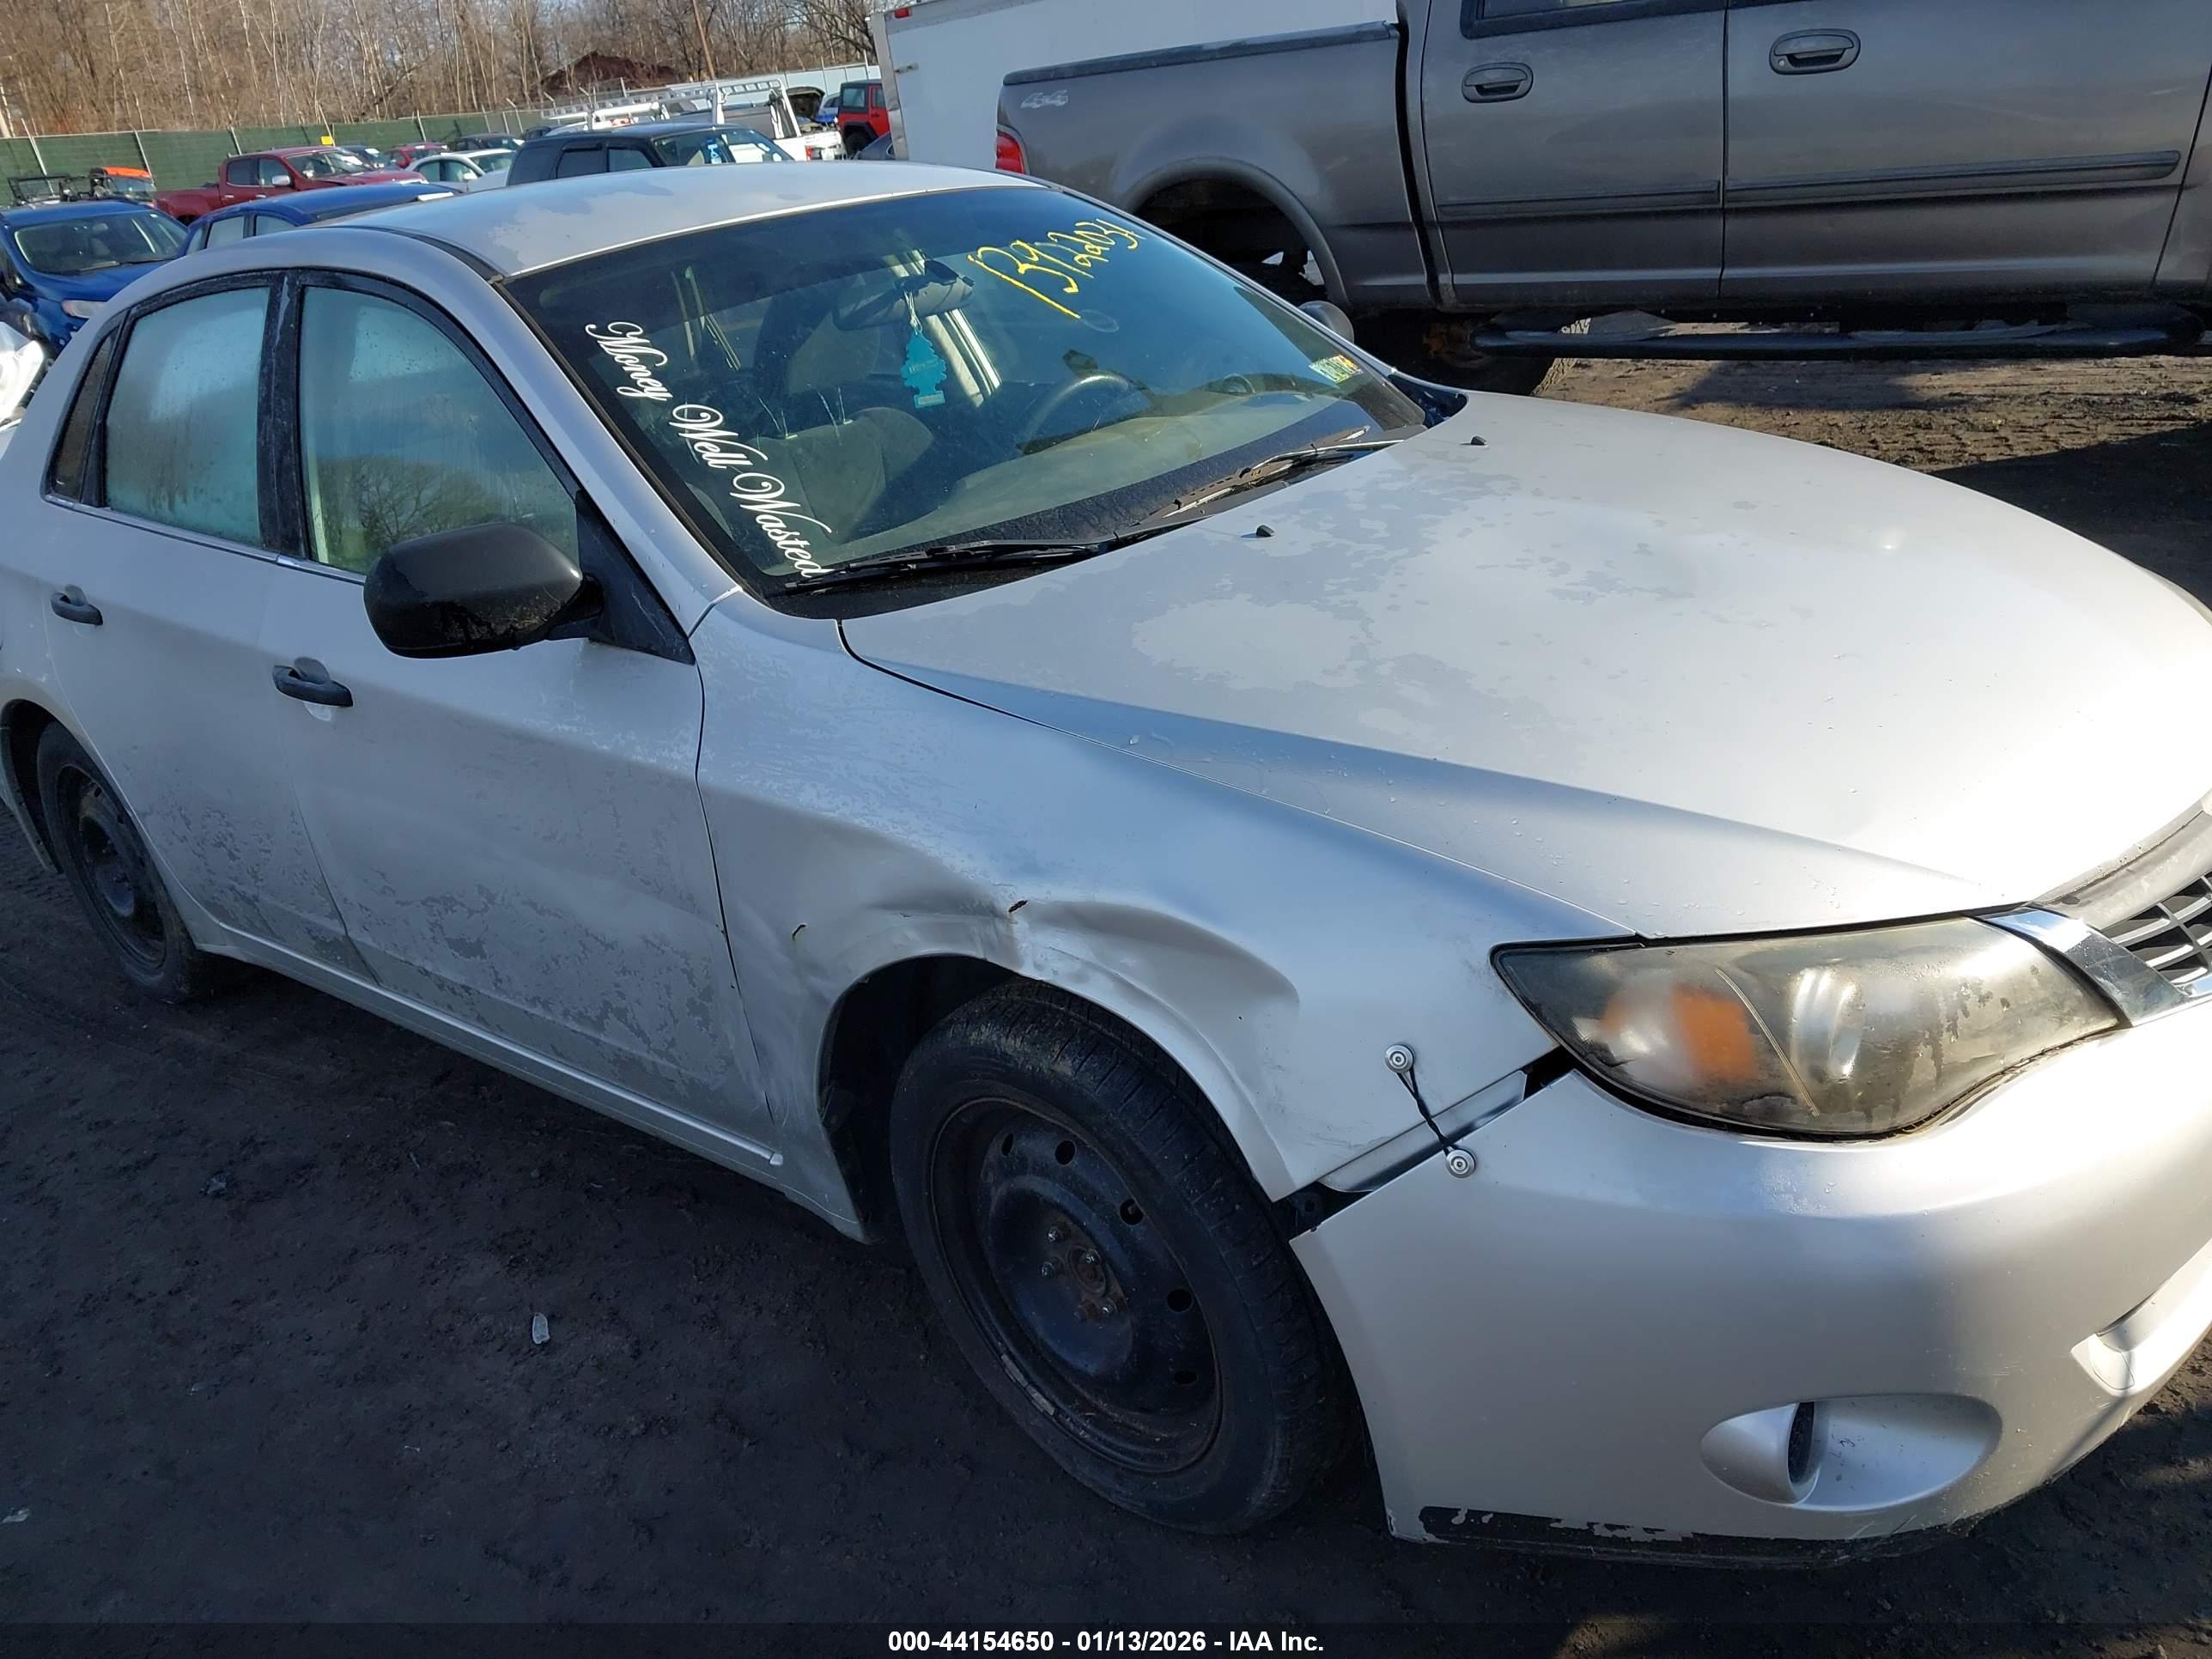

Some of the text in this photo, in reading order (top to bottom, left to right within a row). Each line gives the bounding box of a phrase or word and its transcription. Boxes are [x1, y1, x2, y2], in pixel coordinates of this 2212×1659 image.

[585, 320, 836, 578] Money Well Wasted
